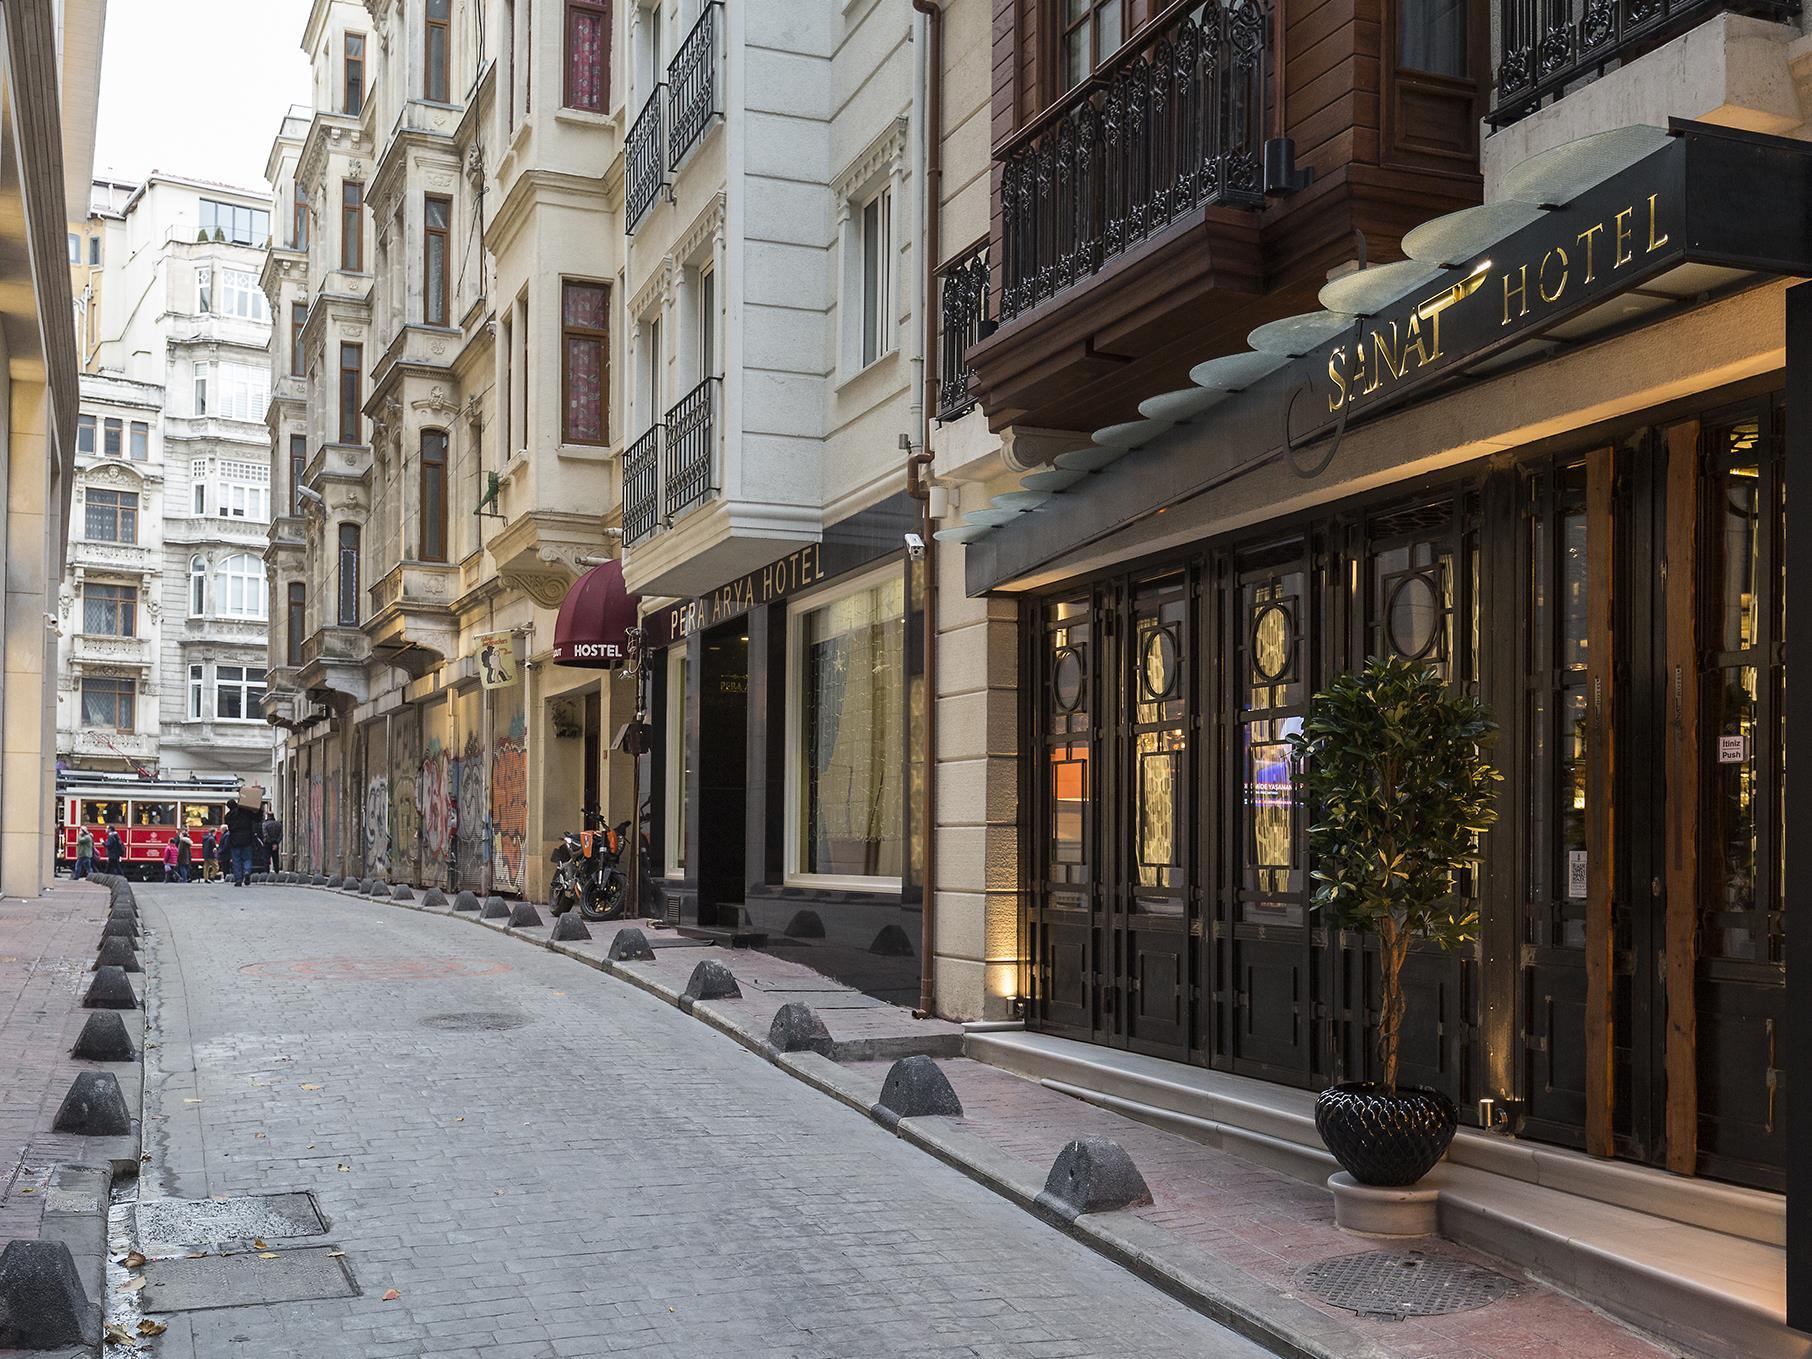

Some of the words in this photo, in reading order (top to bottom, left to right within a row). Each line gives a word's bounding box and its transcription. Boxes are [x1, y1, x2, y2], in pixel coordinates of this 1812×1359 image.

[1328, 260, 1492, 413] SANAT
[1501, 193, 1669, 326] HOTEL
[671, 598, 705, 640] PERA
[712, 575, 754, 623] ARYA
[763, 543, 825, 601] HOTEL
[574, 644, 622, 657] HOSTEL
[1722, 751, 1741, 759] Push
